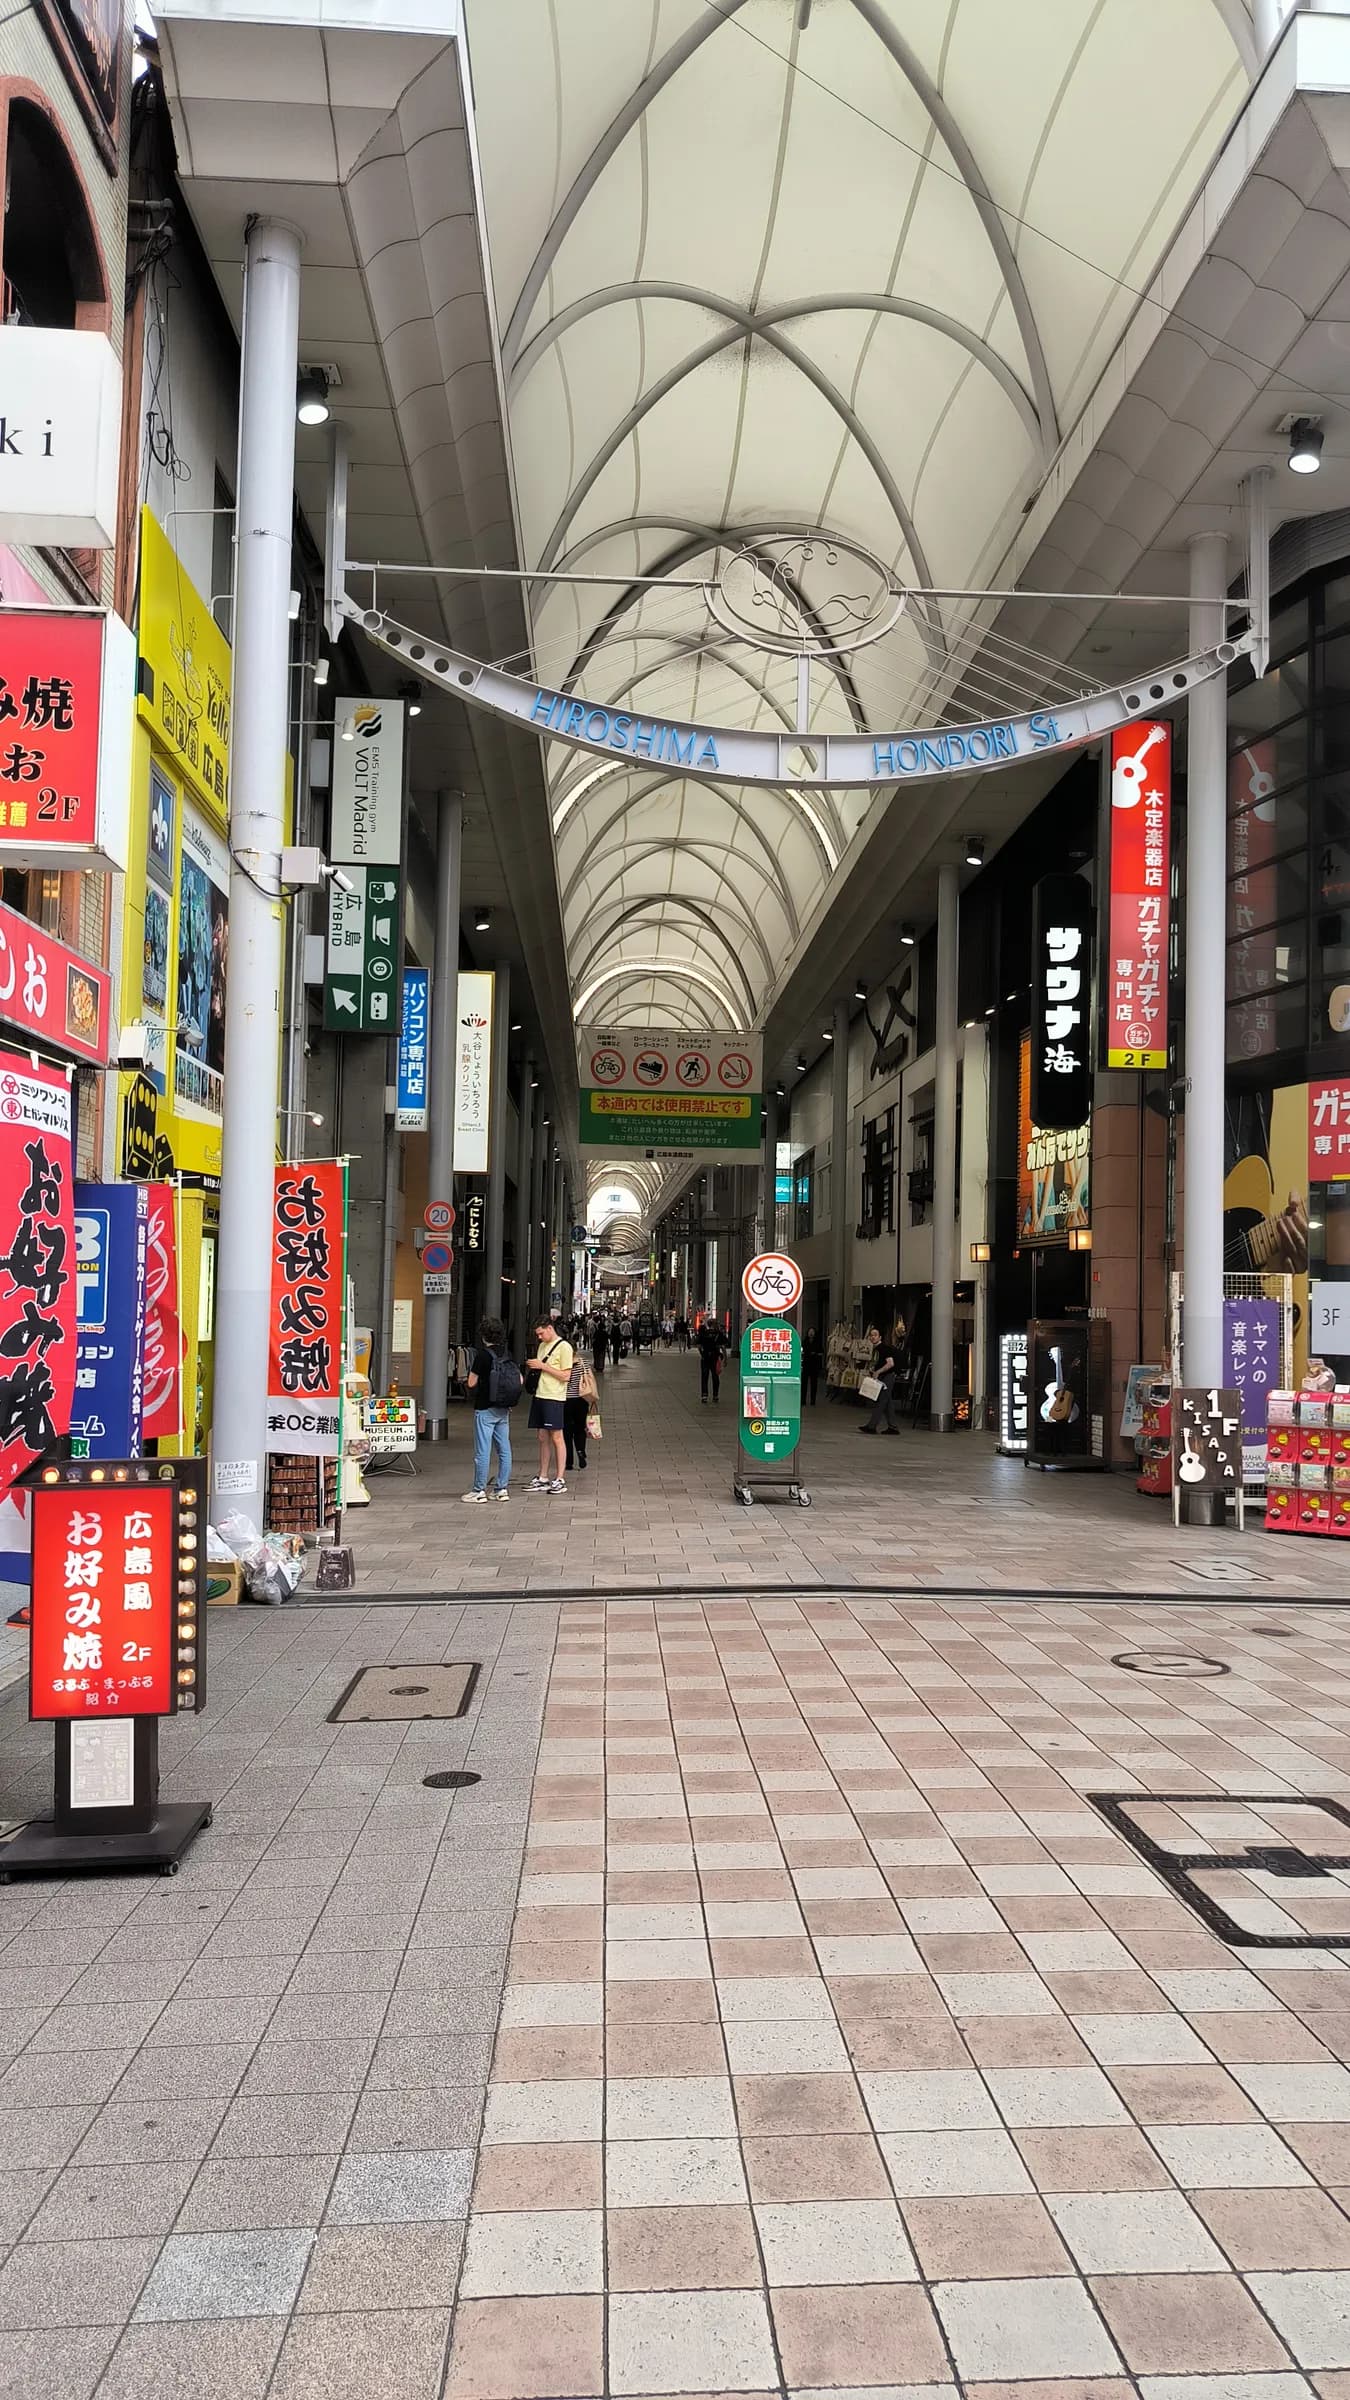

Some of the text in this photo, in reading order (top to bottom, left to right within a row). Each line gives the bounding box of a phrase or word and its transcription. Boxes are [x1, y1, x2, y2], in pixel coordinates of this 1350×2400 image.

[206, 680, 230, 750] Yello
[530, 690, 720, 768] HIROSHIMA
[872, 728, 1018, 775] HONDORI
[37, 786, 80, 821] 2F
[203, 740, 229, 808] 広島
[353, 748, 369, 856] VOLT Madrid
[369, 746, 379, 833] EMS Training gym
[1144, 789, 1164, 887] 木定楽器店
[331, 890, 344, 947] HYBRID
[1136, 896, 1161, 1023] ガチャガチャ
[1043, 927, 1082, 1074] サウナ海
[1115, 958, 1134, 1022] 専門店
[407, 982, 426, 1095] パソコン専門店
[20, 1083, 67, 1110] ミツワソース
[461, 1043, 472, 1111] 乳腺クリニック
[472, 1031, 483, 1119] 大谷しょういちろう
[597, 1096, 744, 1114] 本通内では使用禁止です
[23, 1105, 69, 1132] ヒガシマルソース
[136, 1186, 148, 1202] HB
[136, 1202, 148, 1216] ST
[431, 1209, 449, 1223] 20
[468, 1207, 480, 1249] にしむら
[751, 1328, 792, 1342] 自転車
[1322, 1309, 1341, 1326] 3F
[751, 1342, 792, 1354] 通行禁止
[1252, 1321, 1268, 1384] ヤマハの
[76, 1368, 97, 1389] 店
[368, 1434, 416, 1443] AFE&BAR
[1182, 1398, 1235, 1477] KISADA
[63, 1509, 104, 1672] お好み焼
[122, 1510, 153, 1611] 広島風
[121, 1641, 152, 1663] 2F
[52, 1675, 153, 1692] るるぶ・まっぷる
